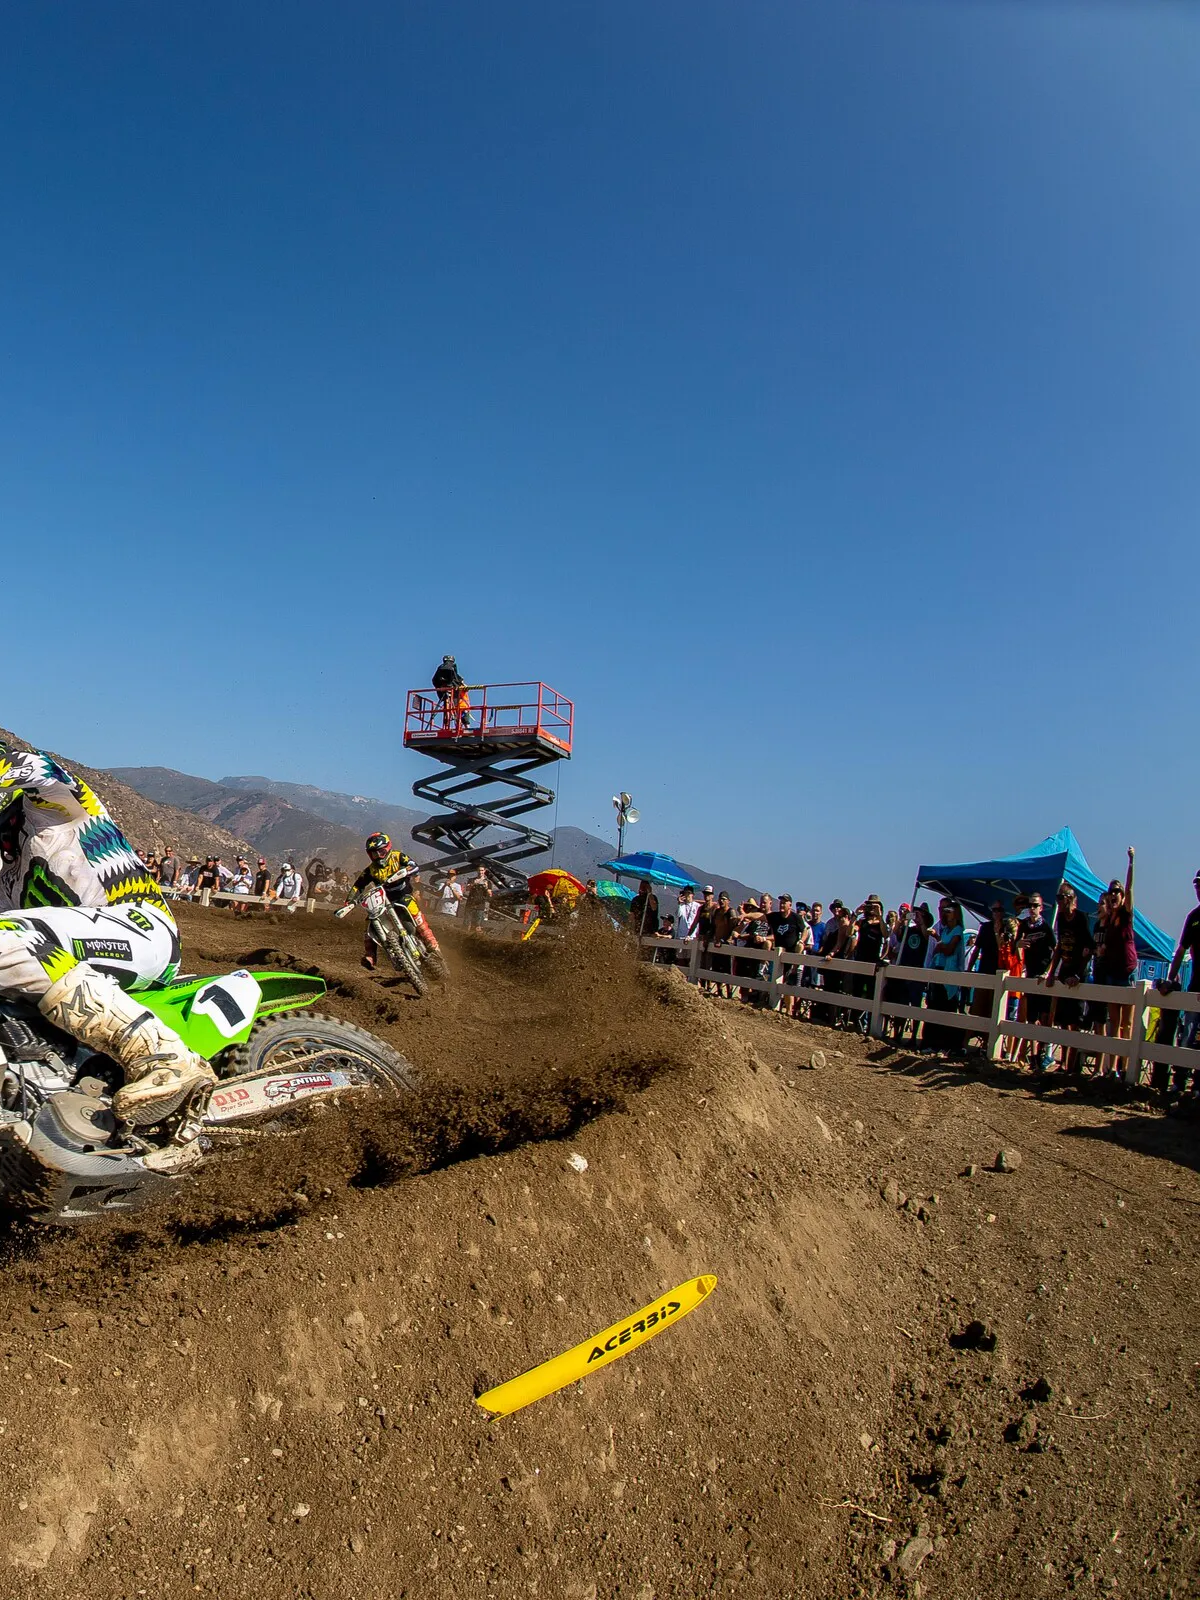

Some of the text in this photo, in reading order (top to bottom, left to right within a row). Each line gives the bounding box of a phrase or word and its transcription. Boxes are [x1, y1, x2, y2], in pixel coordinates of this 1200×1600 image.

[86, 939, 131, 952] MONSTER
[197, 984, 246, 1027] 1
[212, 1088, 250, 1107] DID
